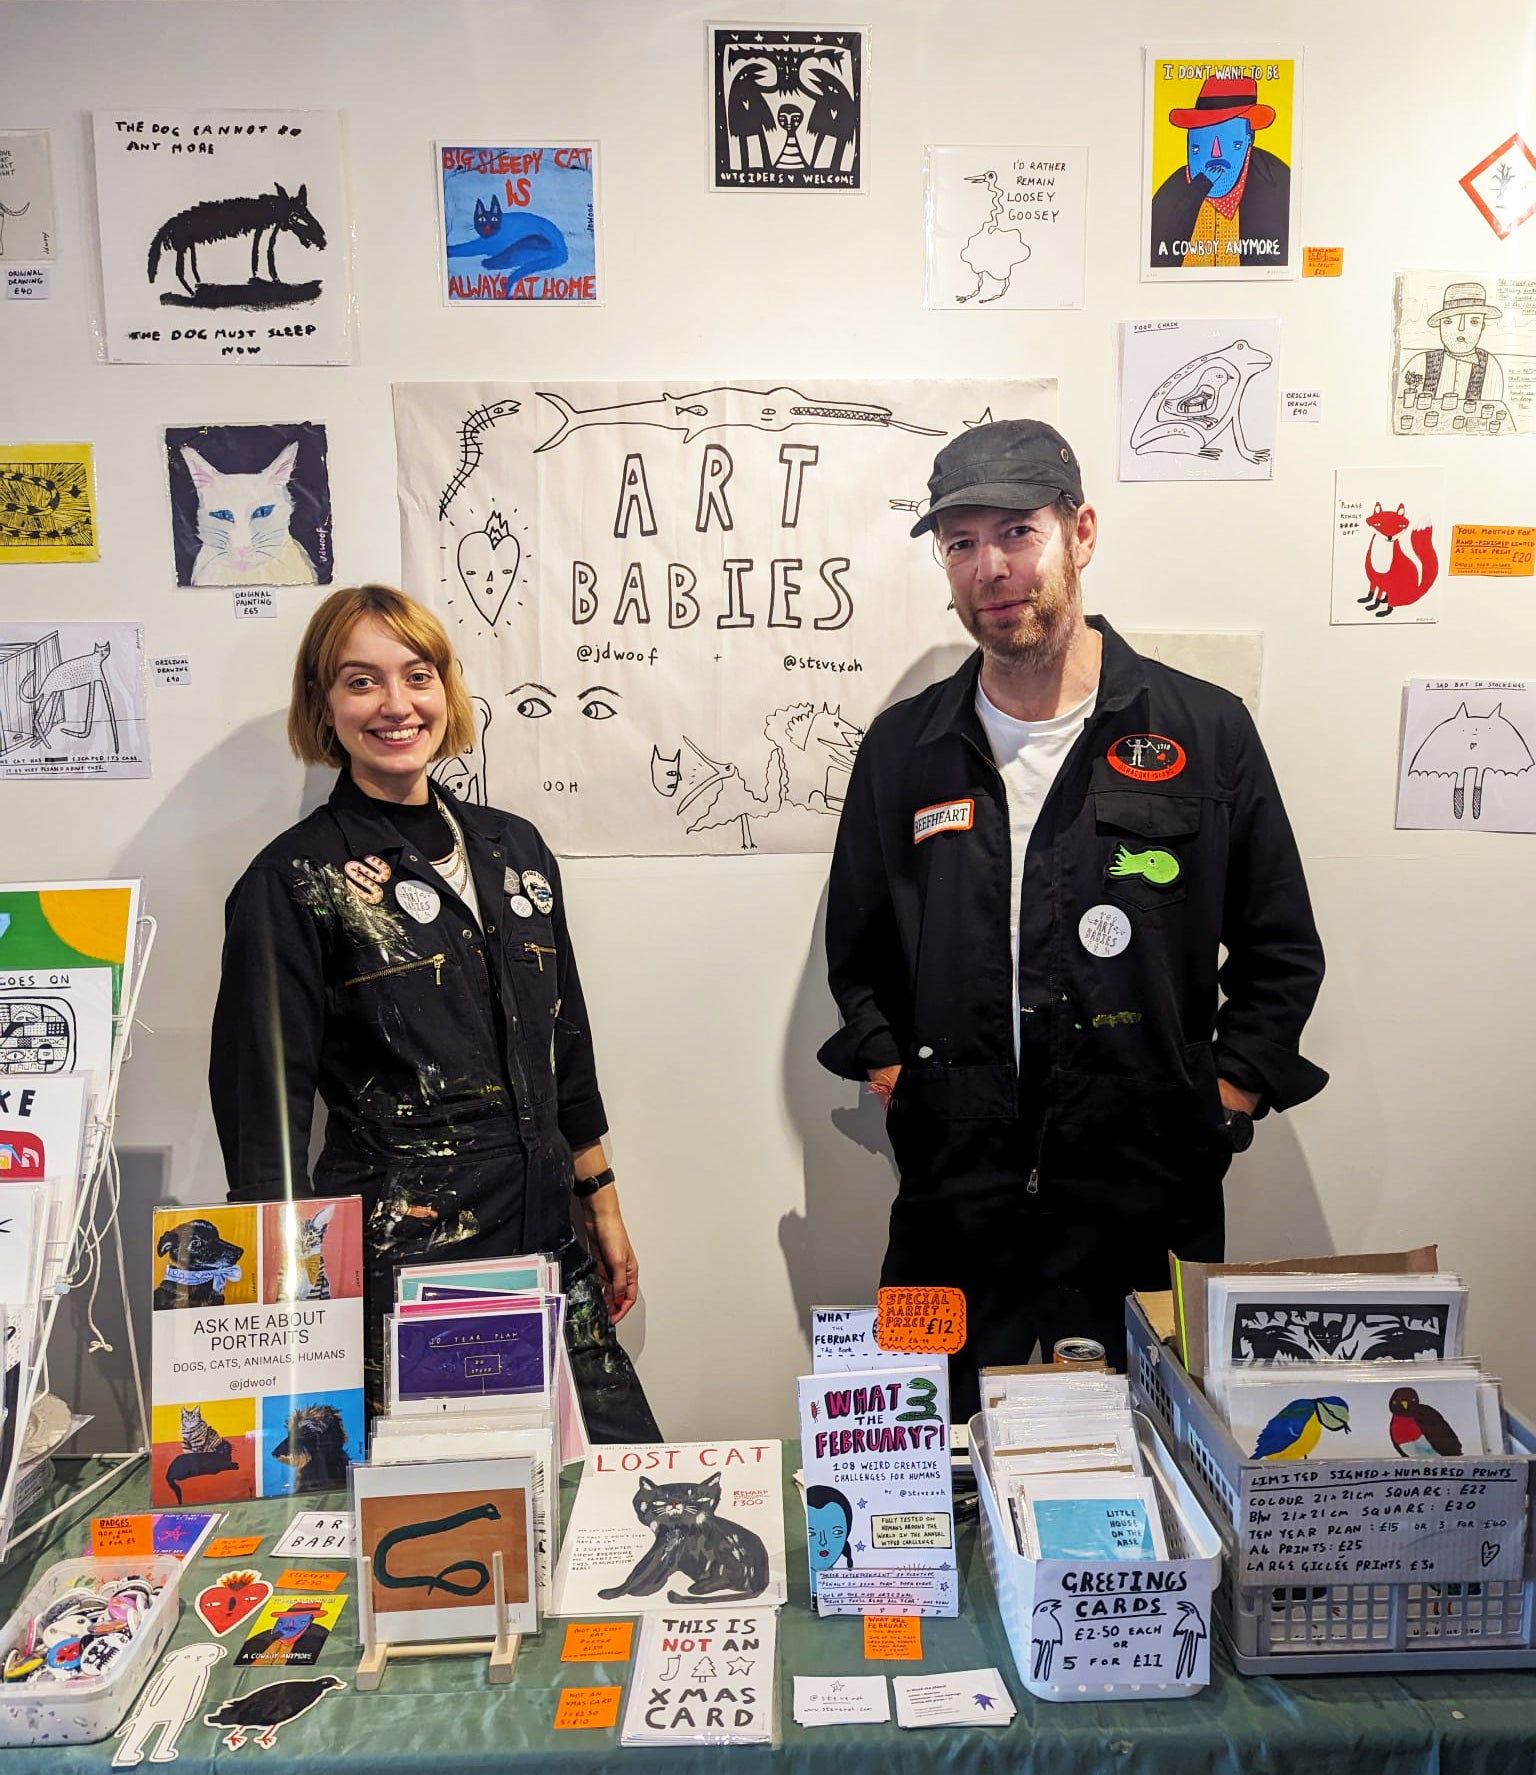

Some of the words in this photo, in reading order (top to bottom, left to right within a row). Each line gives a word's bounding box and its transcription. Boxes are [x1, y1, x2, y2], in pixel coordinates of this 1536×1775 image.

[1163, 64, 1174, 81] I
[1214, 65, 1245, 81] WANT
[1249, 66, 1264, 80] TO
[1266, 66, 1279, 80] BE
[115, 122, 144, 134] THE
[153, 123, 180, 137] DOG
[194, 125, 268, 136] CANNOT
[126, 141, 160, 151] ANY
[172, 143, 214, 155] MORE
[443, 151, 474, 172] BIG
[477, 151, 543, 174] SLEEPY
[554, 149, 592, 168] CAT
[1013, 160, 1025, 170] I'D
[1030, 162, 1067, 171] RATHER
[721, 171, 784, 184] OUTSIDERS
[803, 173, 855, 186] WELCOME
[1017, 176, 1055, 186] REMAIN
[505, 178, 531, 207] IS
[1007, 192, 1056, 202] LOOSEY
[1008, 209, 1059, 223] GOOSEY
[1158, 241, 1168, 256] A
[1172, 240, 1219, 256] COWBOY
[1225, 240, 1281, 256] ANYMORE
[449, 274, 508, 298] ALWAYS
[514, 276, 540, 299] AT
[543, 275, 596, 299] HOME
[128, 330, 161, 342] THE
[172, 329, 207, 341] DOG
[216, 329, 256, 339] MUST
[268, 325, 316, 337] SLEEP
[222, 347, 261, 356] NOW
[614, 444, 819, 538] ART
[1512, 552, 1531, 563] £20
[572, 557, 854, 631] BABIES
[575, 641, 659, 666] @jdwoof
[783, 653, 863, 674] @stevexoh
[543, 779, 578, 795] OOH
[50, 974, 70, 985] ON
[887, 1293, 950, 1305] SPECIAL
[816, 1312, 852, 1323] WHAT
[886, 1306, 939, 1317] MARKET
[193, 1319, 228, 1335] ASK
[235, 1315, 260, 1331] ME
[265, 1310, 326, 1329] ABOUT
[886, 1317, 926, 1328] PRICE
[925, 1319, 954, 1335] £12
[211, 1329, 310, 1351] PORTRAITS
[494, 1332, 518, 1340] PLAN
[815, 1332, 866, 1344] FEBRUARY
[173, 1362, 206, 1373] DOGS,
[210, 1358, 240, 1370] CATS,
[298, 1349, 345, 1362] HUMANS
[229, 1376, 277, 1391] @jdwoof
[824, 1384, 902, 1419] WHAT
[854, 1415, 884, 1425] THE
[815, 1425, 945, 1459] FEBRUARY?!
[597, 1450, 681, 1472] LOST
[699, 1446, 770, 1467] CAT
[833, 1462, 855, 1471] 108
[861, 1461, 890, 1470] WEIRD
[894, 1461, 937, 1469] CREATIVE
[834, 1473, 886, 1483] CHALLENGES
[891, 1472, 904, 1480] FOR
[909, 1471, 941, 1479] HUMANS
[1251, 1471, 1318, 1486] LIMITED
[1330, 1469, 1378, 1480] SIGNED
[1394, 1467, 1464, 1478] NUMBERED
[1472, 1467, 1511, 1478] PRINTS
[1249, 1495, 1304, 1507] COLOUR
[100, 1519, 129, 1527] BADGES
[1249, 1529, 1272, 1540] TEN
[1279, 1527, 1317, 1538] YEAR
[1415, 1522, 1427, 1530] OR
[1457, 1520, 1474, 1528] FOR
[1246, 1561, 1294, 1572] LARGE
[1356, 1560, 1401, 1571] PRINTS
[1062, 1570, 1187, 1593] GREETINGS
[1075, 1598, 1162, 1618] CARDS
[662, 1619, 718, 1634] THIS
[726, 1619, 757, 1634] IS
[1129, 1625, 1162, 1635] EACH
[662, 1638, 712, 1652] NOT
[722, 1638, 759, 1651] AN
[1113, 1640, 1128, 1648] OR
[1063, 1656, 1077, 1670] 5
[1090, 1658, 1121, 1667] FOR
[1133, 1654, 1163, 1668] £11
[648, 1688, 756, 1704] XMAS
[645, 1706, 754, 1729] CARD
